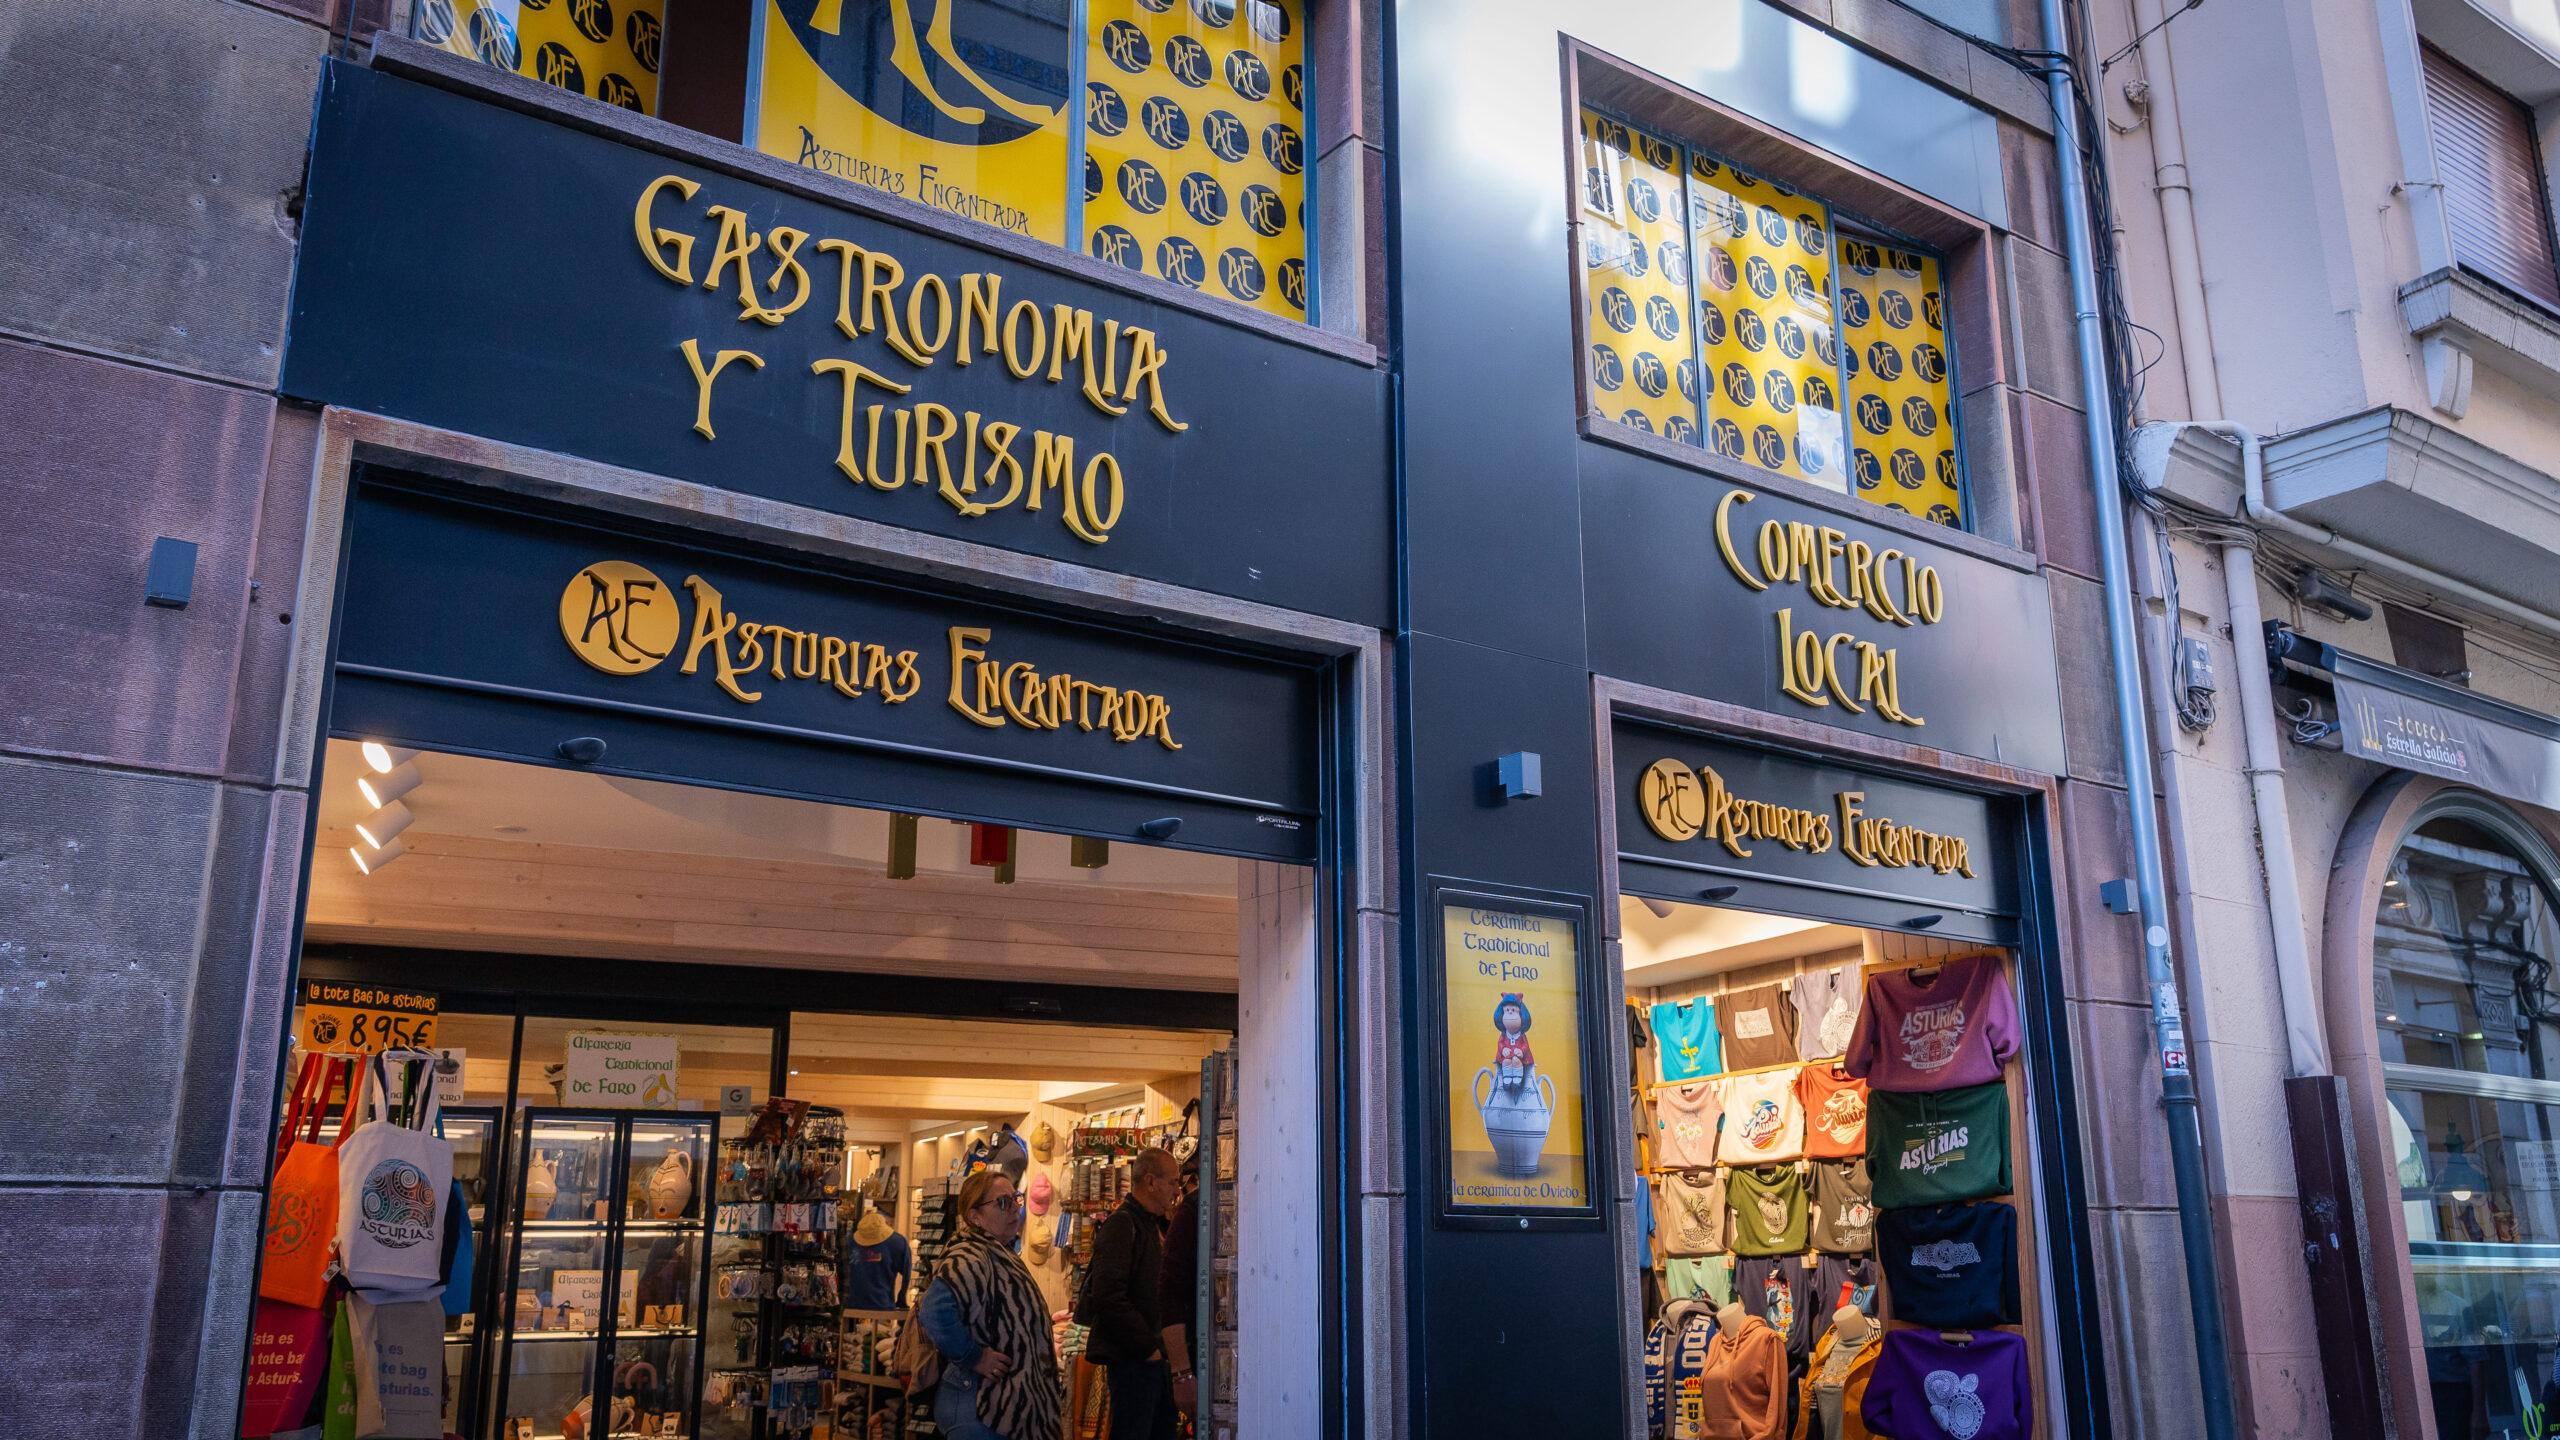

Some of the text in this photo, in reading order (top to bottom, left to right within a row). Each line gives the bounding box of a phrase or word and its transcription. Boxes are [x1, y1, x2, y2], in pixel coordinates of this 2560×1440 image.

[634, 175, 1189, 433] GASTRONOMIA
[680, 338, 1125, 545] Y TURISMO
[1713, 489, 1944, 627] COMERCIO
[680, 573, 922, 704] ASTURIAS
[948, 626, 1183, 750] ENCANTADA
[1777, 607, 1925, 727] LOCAL
[2386, 731, 2457, 766] Estrella Galicia
[1698, 764, 1833, 859] ASTURIAS
[1838, 791, 1978, 879] ENCANTADA
[1463, 932, 1550, 958] Tradicional
[1478, 959, 1539, 982] de Faro
[323, 986, 350, 1001] tote
[1900, 1001, 1966, 1037] ASTURIAS
[605, 1057, 673, 1071] Tradicional
[572, 1078, 637, 1096] de Faro
[1900, 1126, 1969, 1170] ASTURIAS
[1452, 1178, 1464, 1196] la
[1523, 1185, 1537, 1198] de
[1540, 1182, 1579, 1199] Oviedo
[359, 1219, 436, 1242] ASTURIAS
[278, 1333, 294, 1345] es
[257, 1351, 283, 1366] tote
[401, 1364, 427, 1380] bag
[379, 1383, 435, 1397] sturias.
